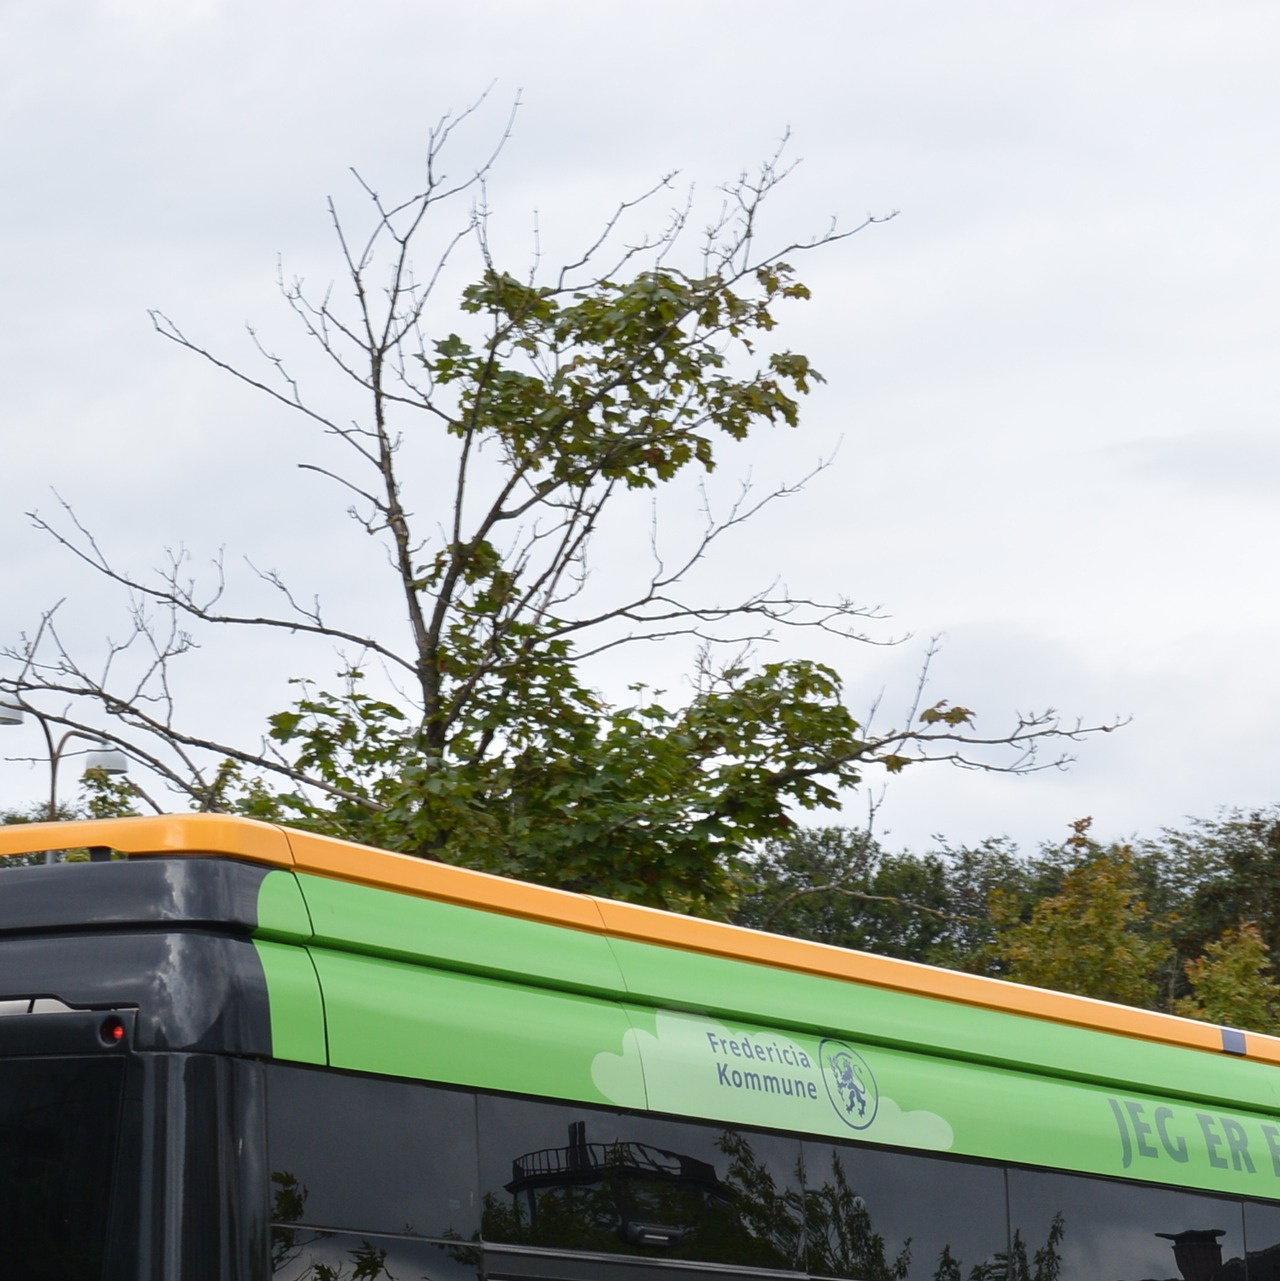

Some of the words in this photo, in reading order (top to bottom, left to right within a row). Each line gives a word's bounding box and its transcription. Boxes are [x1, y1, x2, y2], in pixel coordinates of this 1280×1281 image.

[706, 1032, 811, 1068] Fredericia
[716, 1062, 817, 1100] Kommune
[1108, 1098, 1189, 1169] JEG
[1196, 1112, 1258, 1174] ER
